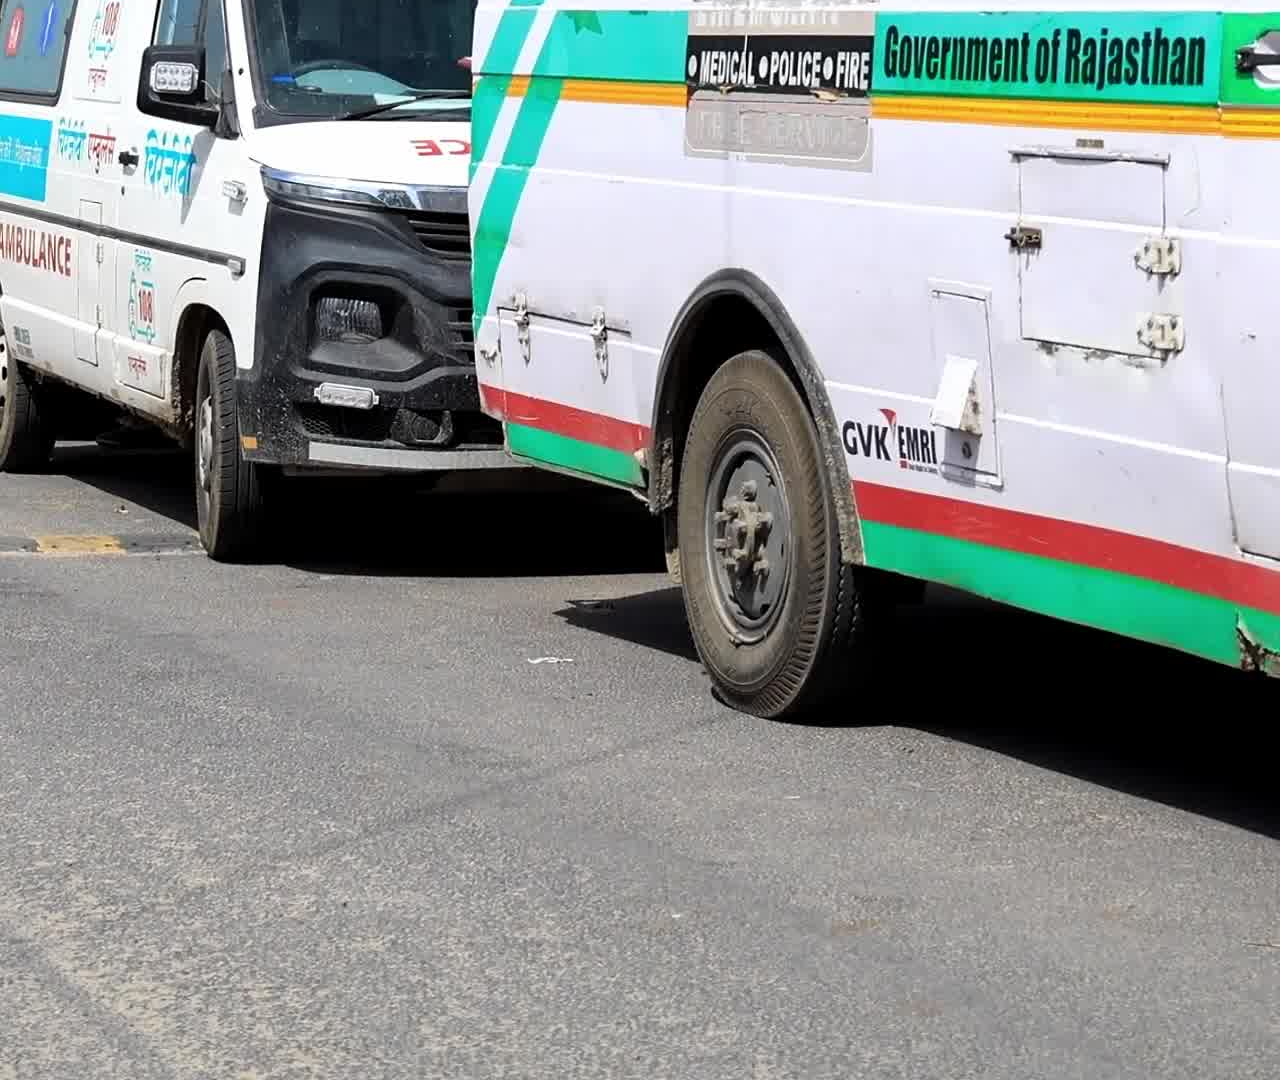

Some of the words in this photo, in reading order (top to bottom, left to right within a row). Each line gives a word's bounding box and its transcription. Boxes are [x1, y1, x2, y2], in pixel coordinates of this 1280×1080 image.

[699, 50, 755, 87] MEDICAL
[769, 50, 822, 89] POLICE
[835, 51, 870, 90] FIRE
[883, 25, 1030, 83] Government
[1034, 27, 1062, 85] of
[1063, 27, 1207, 91] Rajasthan
[842, 420, 893, 461] GVK
[896, 425, 938, 466] EMRI
